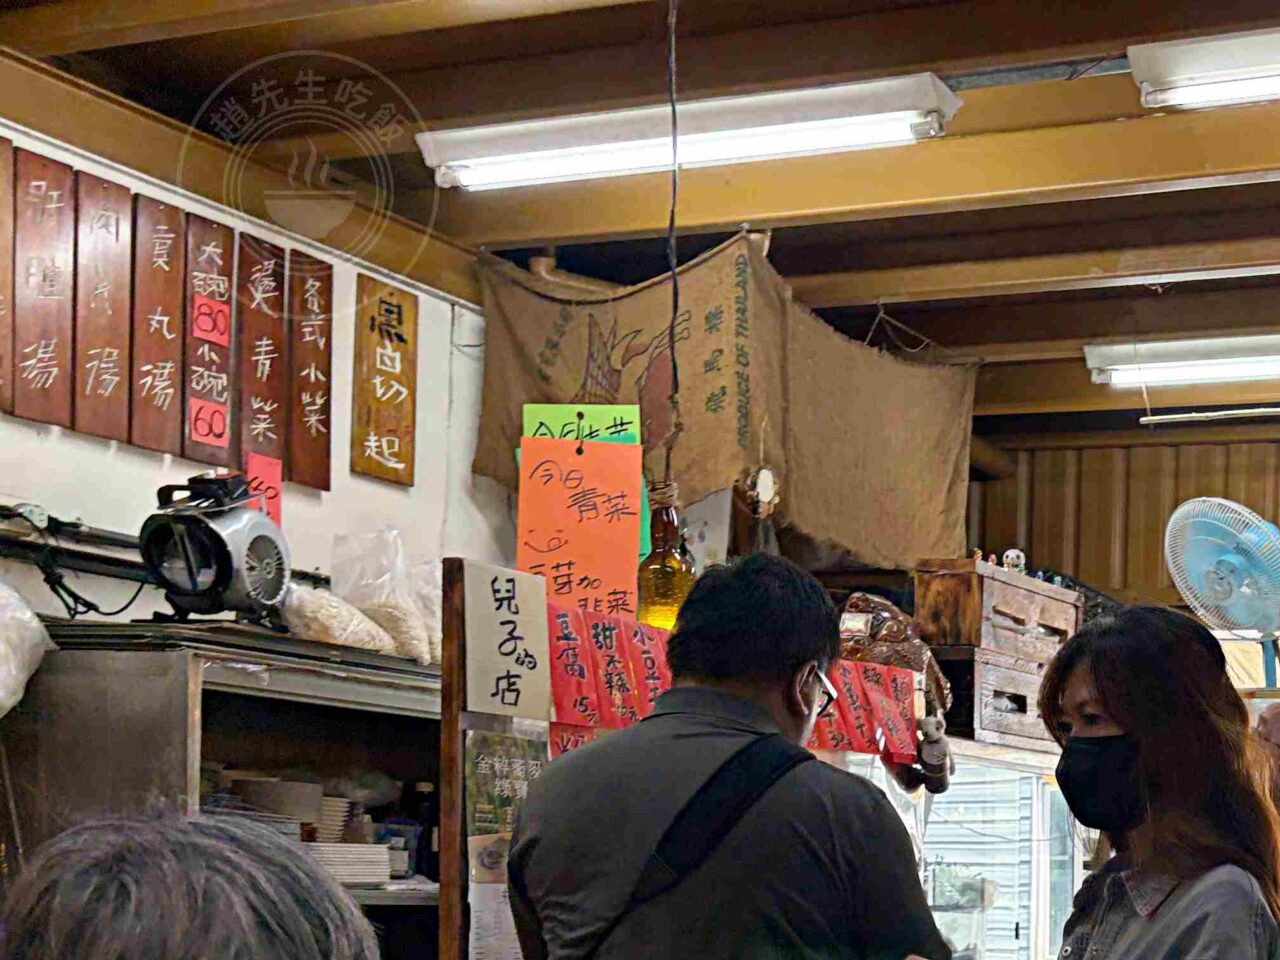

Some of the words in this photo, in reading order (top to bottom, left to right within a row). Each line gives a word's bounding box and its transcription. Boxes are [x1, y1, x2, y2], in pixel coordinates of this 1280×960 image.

[194, 302, 229, 336] 80
[193, 405, 227, 440] 60
[529, 459, 584, 490] 今日
[566, 486, 638, 523] 青菜
[490, 575, 538, 707] 兒子的店
[555, 613, 586, 680] 豆腐
